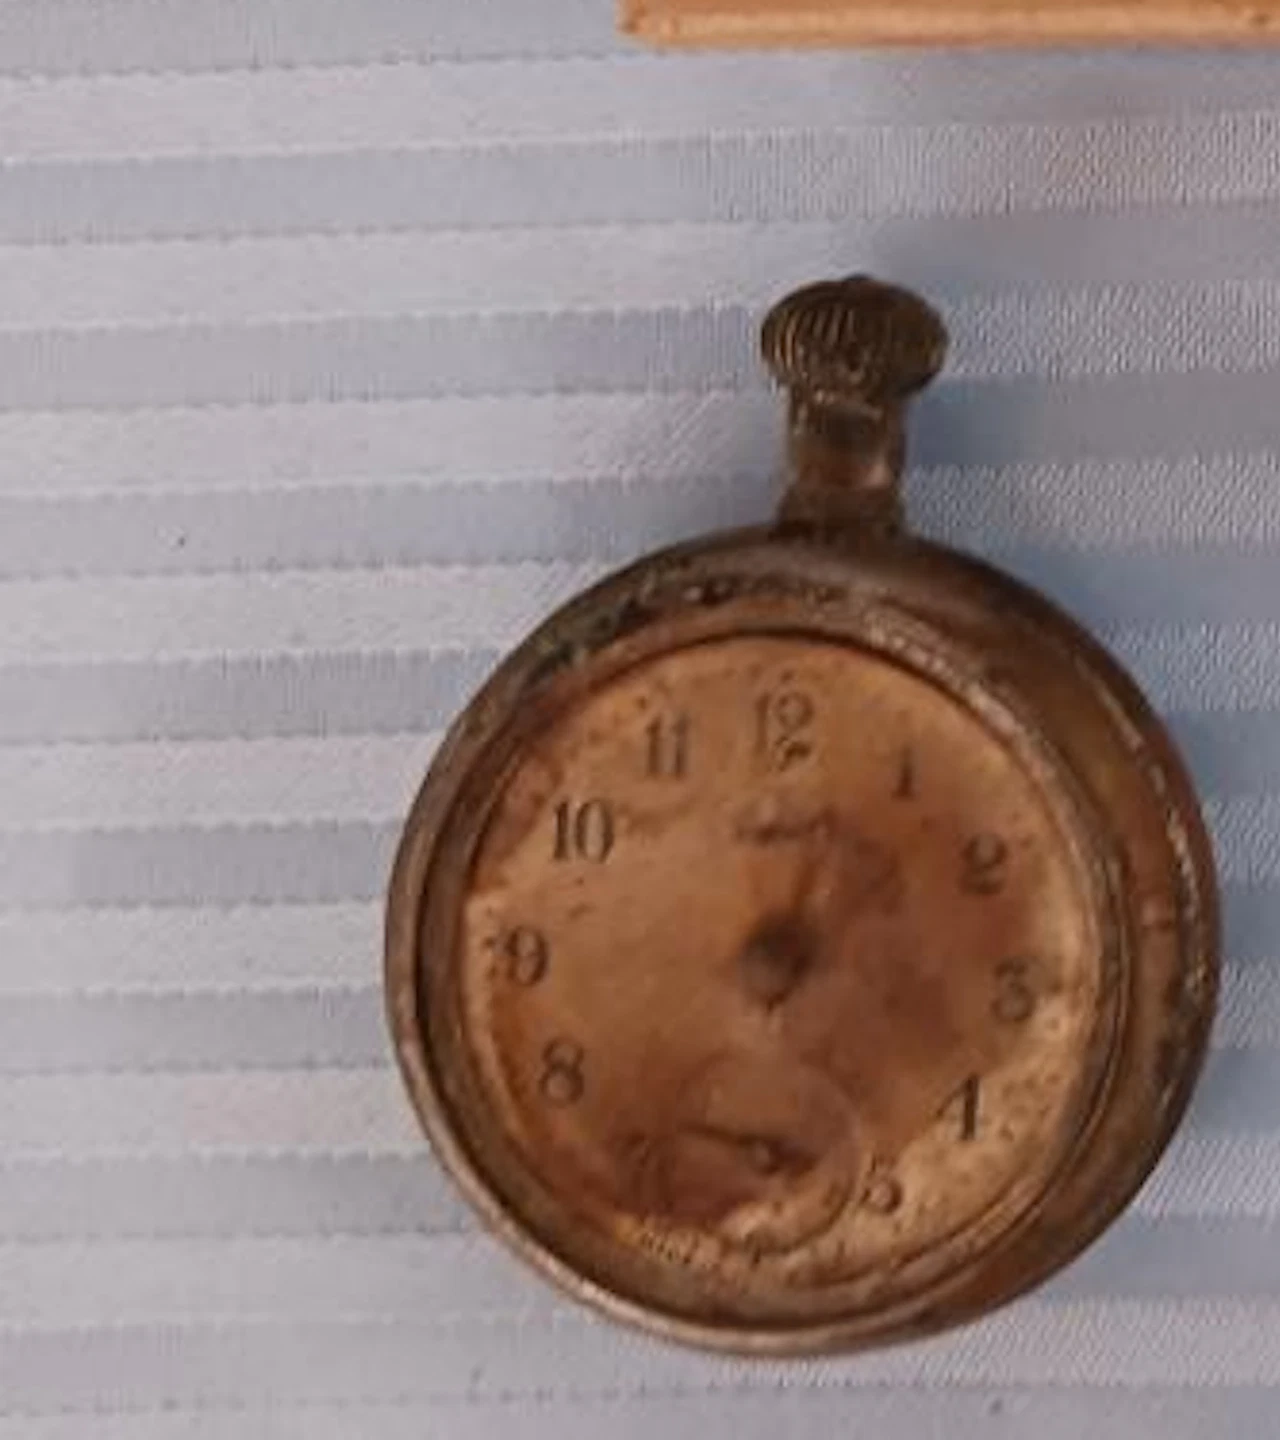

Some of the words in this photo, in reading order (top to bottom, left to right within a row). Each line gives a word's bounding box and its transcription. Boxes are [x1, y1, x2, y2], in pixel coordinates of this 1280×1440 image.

[644, 714, 691, 783] 11
[754, 689, 813, 762] 12
[552, 797, 615, 865] 10
[960, 835, 1008, 895] 2
[506, 926, 549, 987] 9
[540, 1039, 585, 1109] 8
